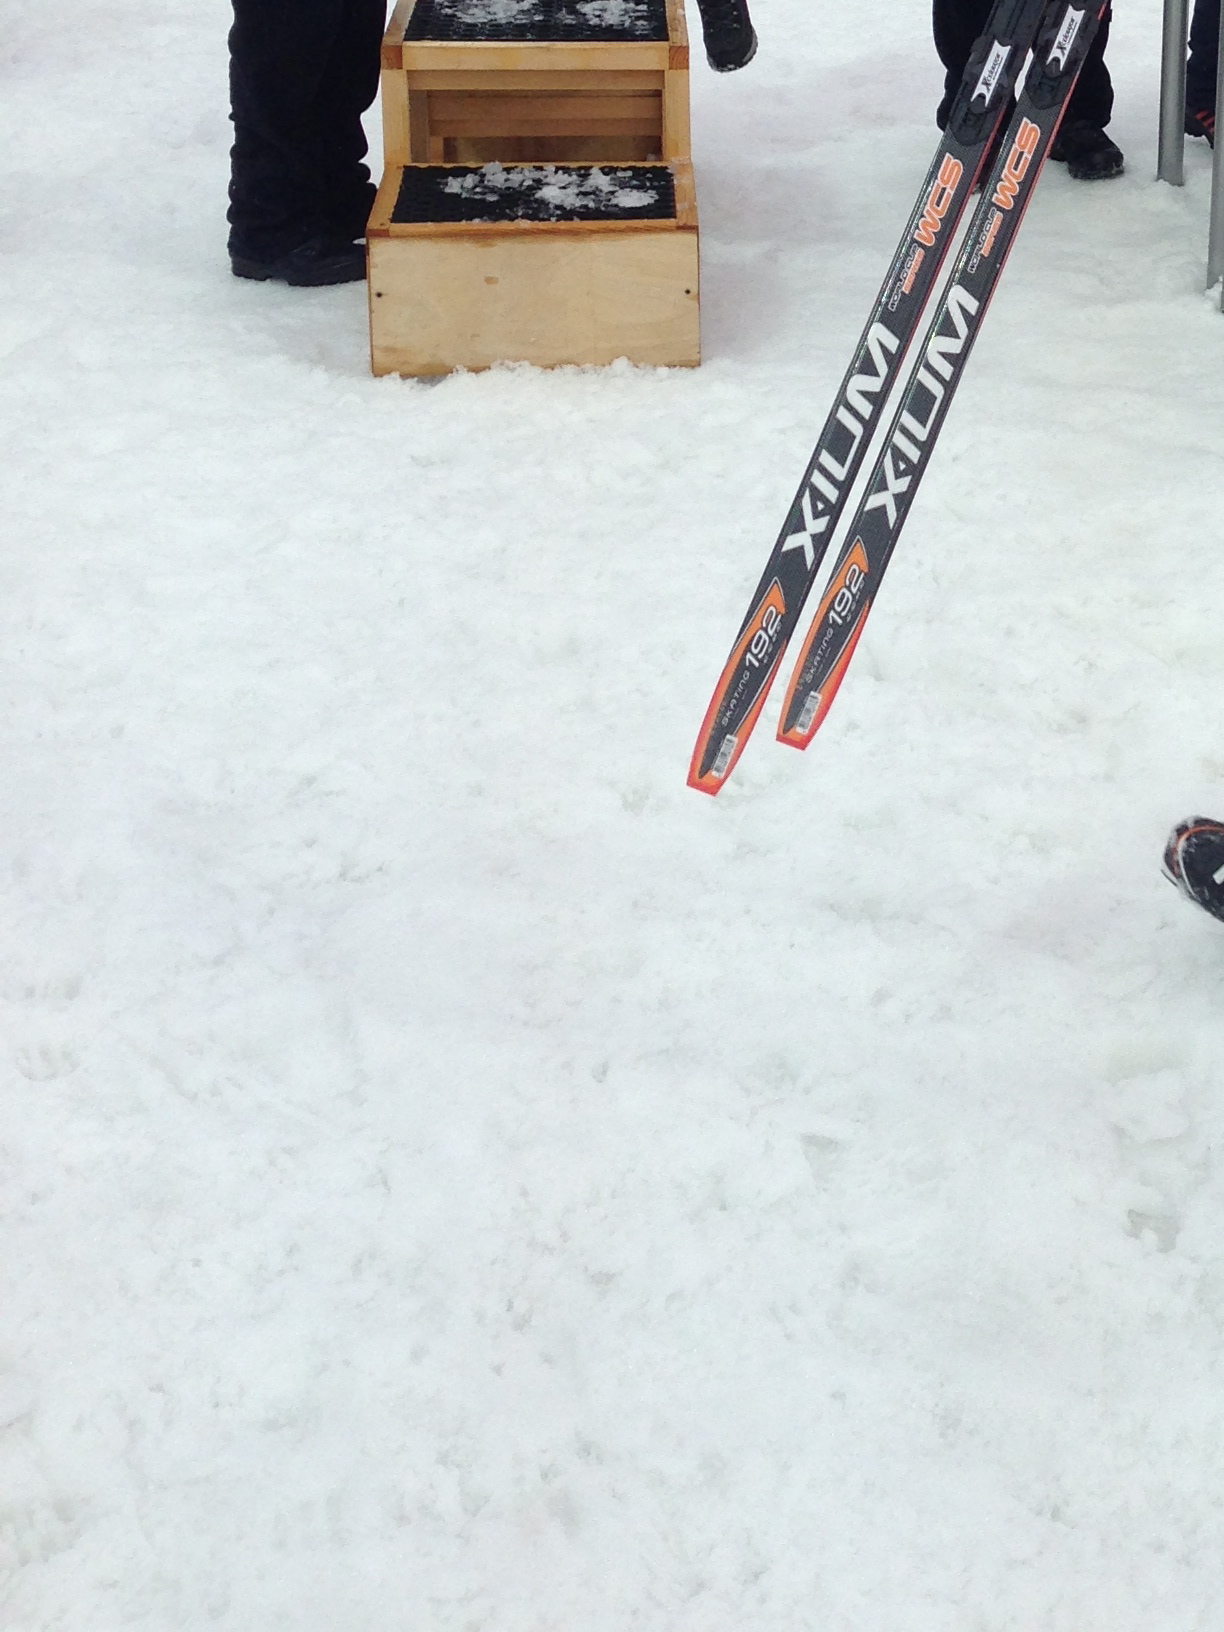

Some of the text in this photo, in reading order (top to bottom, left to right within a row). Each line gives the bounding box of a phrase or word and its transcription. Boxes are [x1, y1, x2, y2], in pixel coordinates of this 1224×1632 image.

[991, 116, 1041, 211] WCS
[913, 151, 964, 248] WCS
[827, 561, 866, 627] 192
[744, 604, 783, 669] 192
[804, 627, 835, 685] SKATING
[720, 669, 751, 727] SKATING
